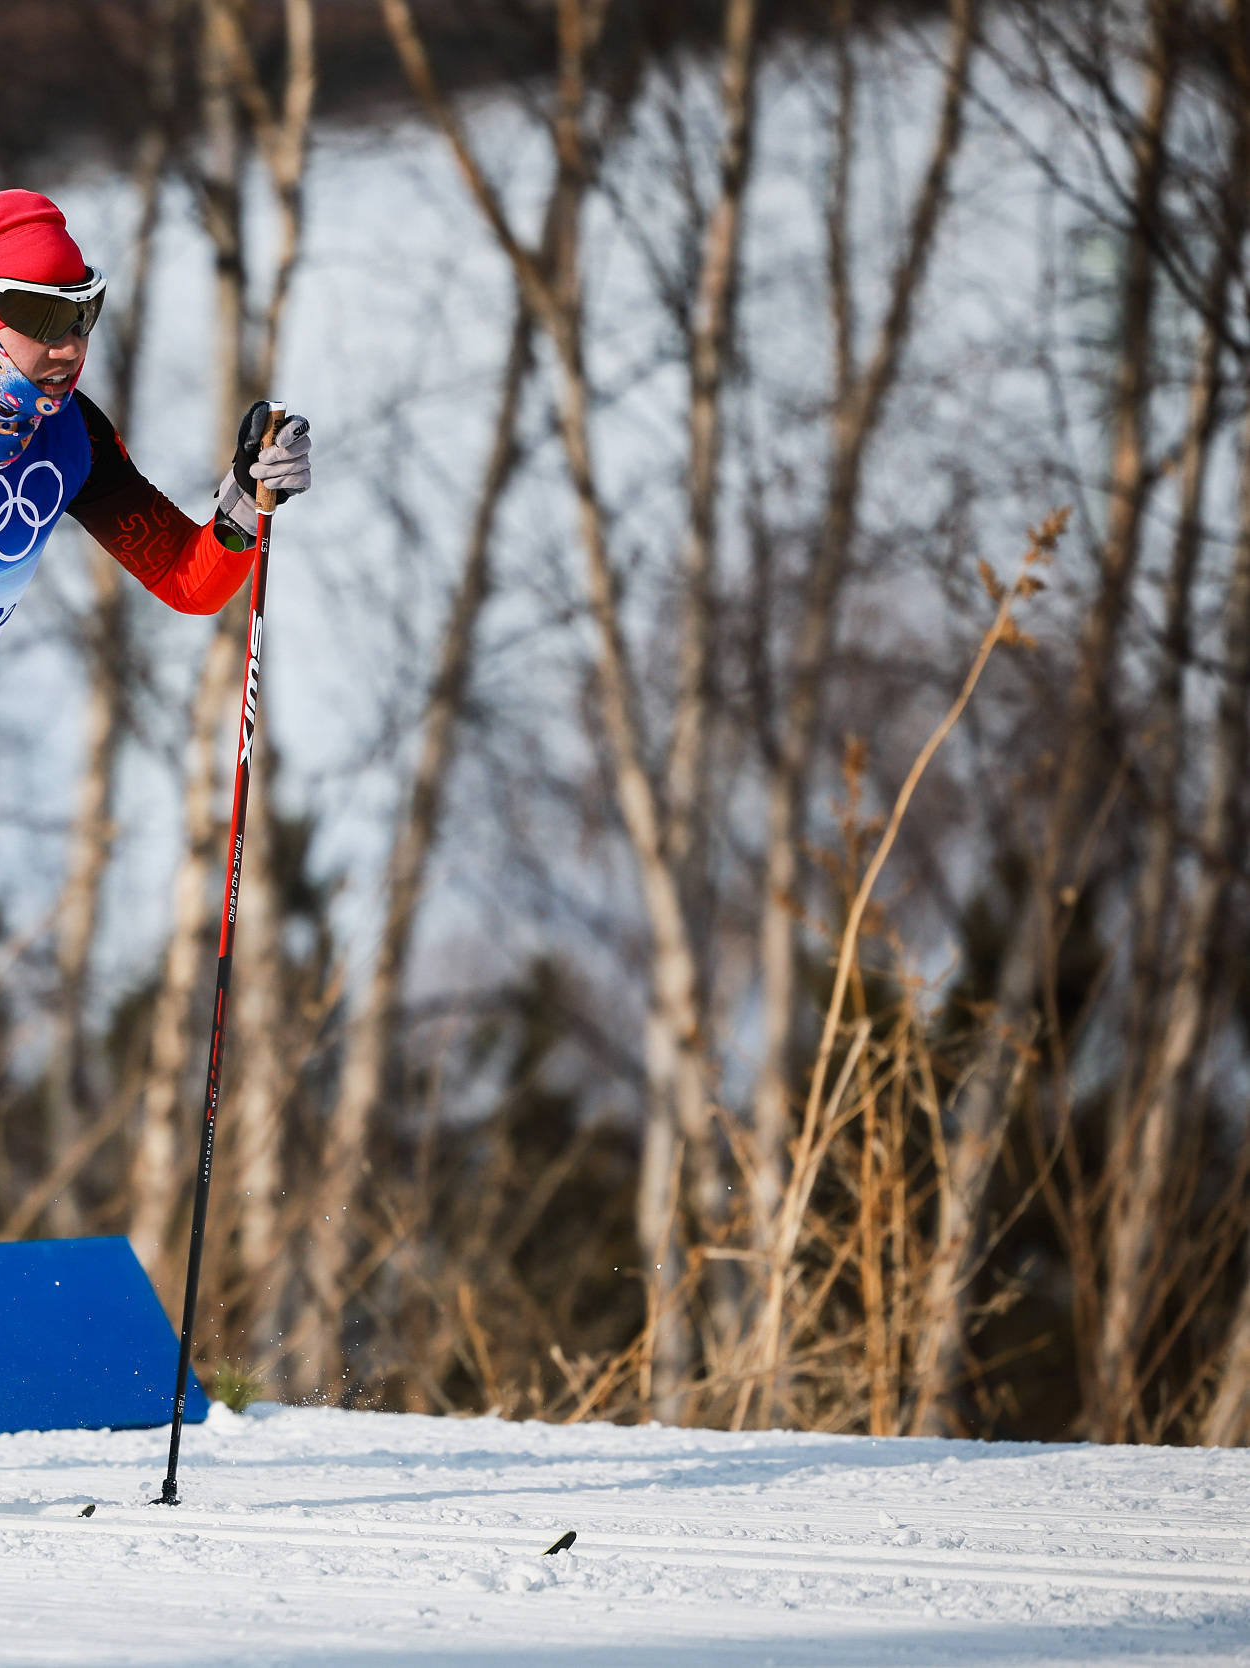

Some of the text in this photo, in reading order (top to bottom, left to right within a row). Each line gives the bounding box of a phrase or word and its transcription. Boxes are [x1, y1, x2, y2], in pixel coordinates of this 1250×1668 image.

[239, 609, 264, 775] SWIX
[233, 833, 243, 869] TRIAC
[228, 888, 237, 923] AERO
